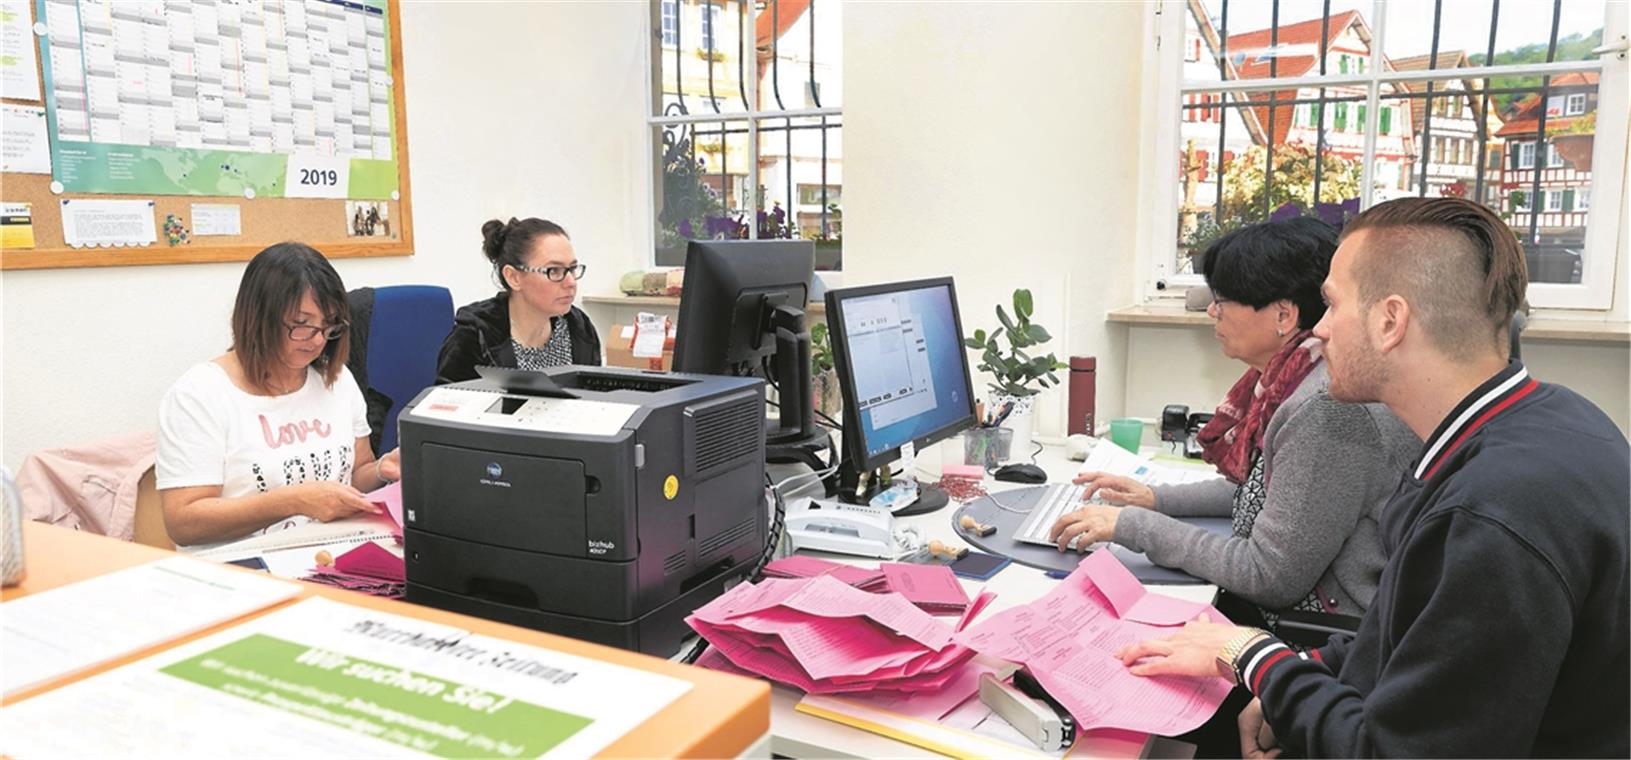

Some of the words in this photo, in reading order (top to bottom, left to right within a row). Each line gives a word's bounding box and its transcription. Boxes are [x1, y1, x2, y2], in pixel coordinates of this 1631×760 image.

[300, 168, 337, 186] 2019
[258, 414, 331, 449] love
[588, 540, 615, 549] bizhub
[295, 648, 352, 670] Wir
[342, 661, 446, 696] suchen
[442, 684, 516, 714] Sie!
